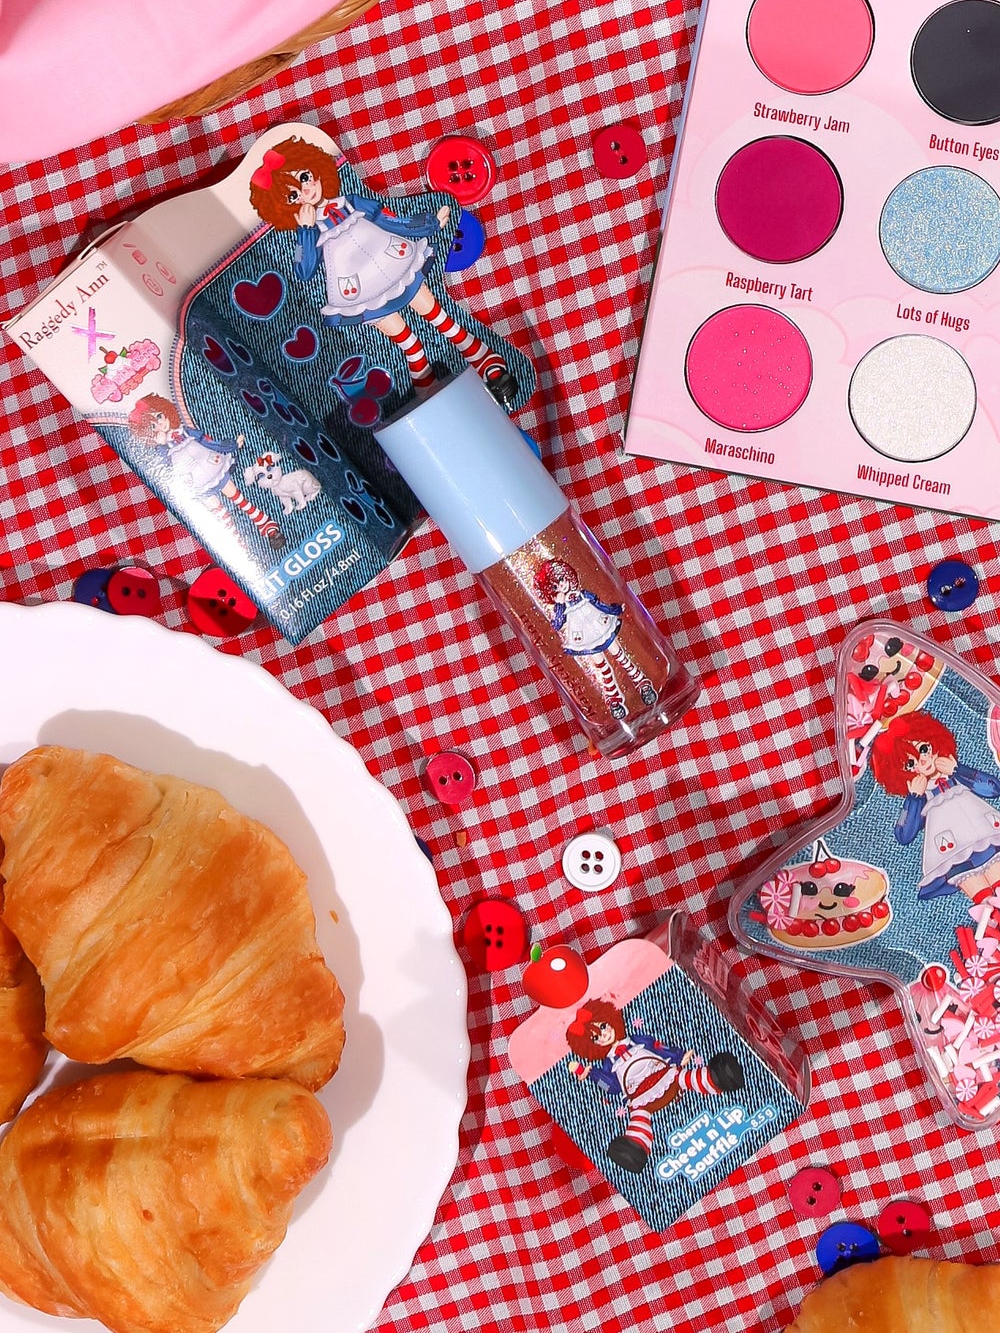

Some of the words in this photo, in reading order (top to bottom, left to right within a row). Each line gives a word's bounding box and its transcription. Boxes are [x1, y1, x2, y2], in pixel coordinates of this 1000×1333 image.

[754, 102, 821, 131] Strawberry
[824, 115, 850, 133] Jam
[929, 134, 969, 156] Button
[973, 141, 1000, 161] Eyes
[725, 271, 787, 300] Raspberry
[791, 283, 813, 302] Tart
[18, 299, 78, 350] Raggedy
[896, 303, 922, 323] Lots
[925, 310, 938, 324] of
[941, 313, 970, 332] Hugs
[705, 437, 775, 464] Maraschino
[857, 464, 910, 488] Whipped
[913, 474, 951, 495] Cream
[284, 524, 341, 576] GLOSS
[280, 597, 304, 620] 0.16
[659, 1137, 707, 1178] Cheek
[717, 1108, 744, 1129] Lip
[670, 1114, 709, 1147] Cherry
[685, 1132, 738, 1178] Soufflé
[751, 1113, 765, 1127] 8.5
[765, 1109, 774, 1119] g
